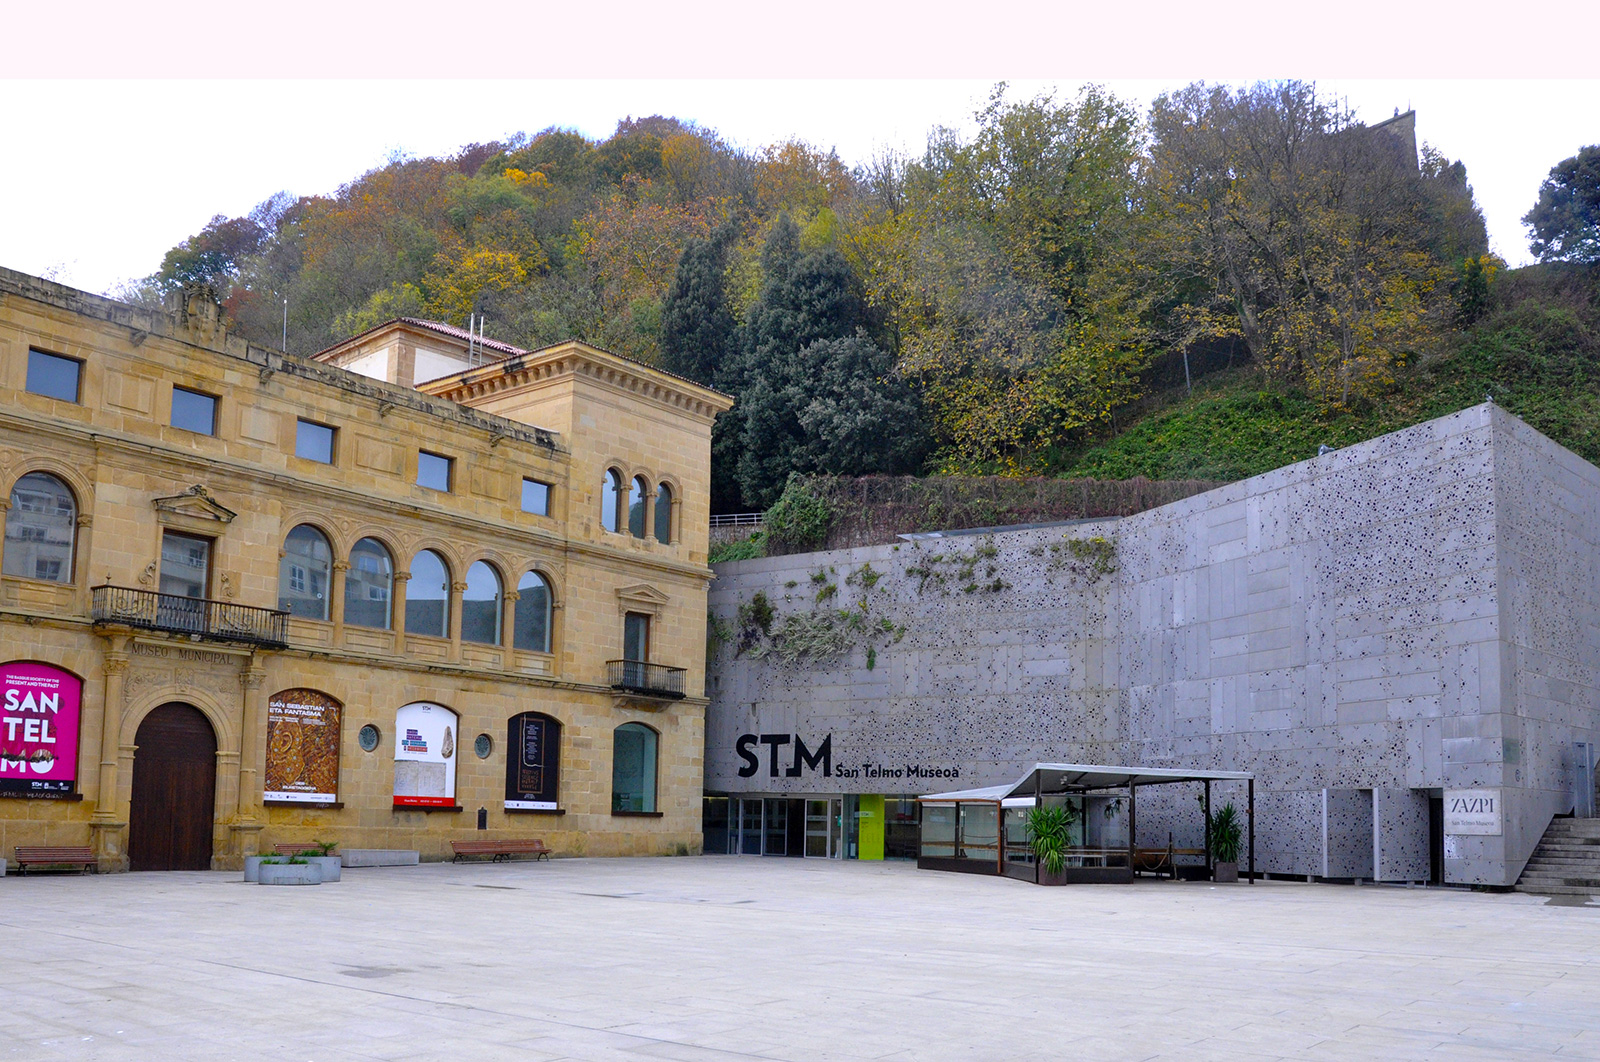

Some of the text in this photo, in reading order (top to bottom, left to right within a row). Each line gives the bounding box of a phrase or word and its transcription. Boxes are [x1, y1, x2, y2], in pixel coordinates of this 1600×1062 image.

[131, 643, 234, 665] MUSEO MUNICIPAL
[4, 689, 59, 714] SAN
[284, 708, 322, 717] FANTASMA
[286, 703, 325, 711] SEBASTIAN
[3, 717, 56, 743] TEL
[736, 733, 959, 779] STM San Telmo Museoa
[1451, 798, 1493, 812] ZAZPI
